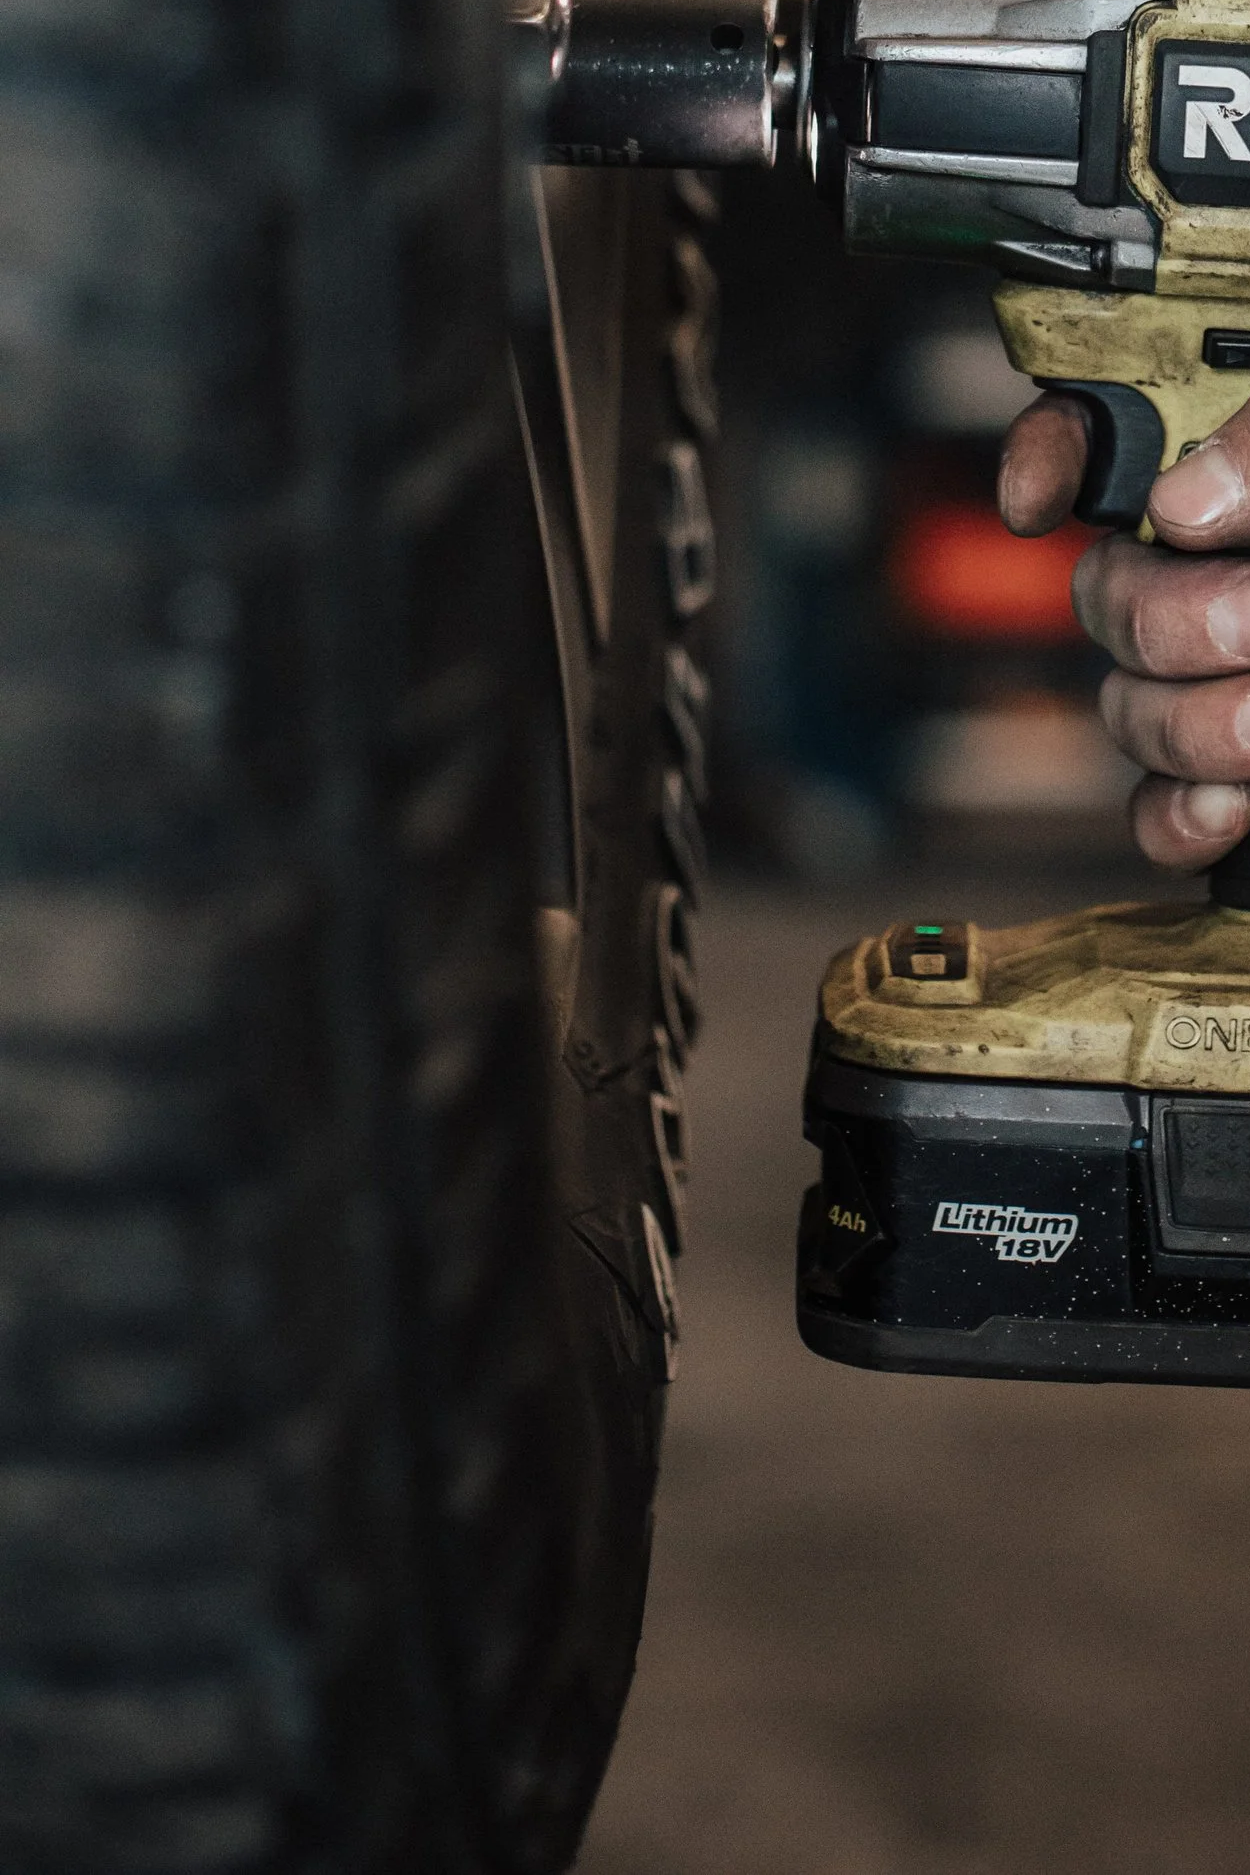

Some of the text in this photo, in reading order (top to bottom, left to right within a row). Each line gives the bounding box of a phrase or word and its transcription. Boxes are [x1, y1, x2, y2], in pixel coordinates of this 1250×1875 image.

[827, 1203, 867, 1234] 4Ah
[938, 1206, 1074, 1235] Lithium
[1001, 1238, 1066, 1260] 18V
